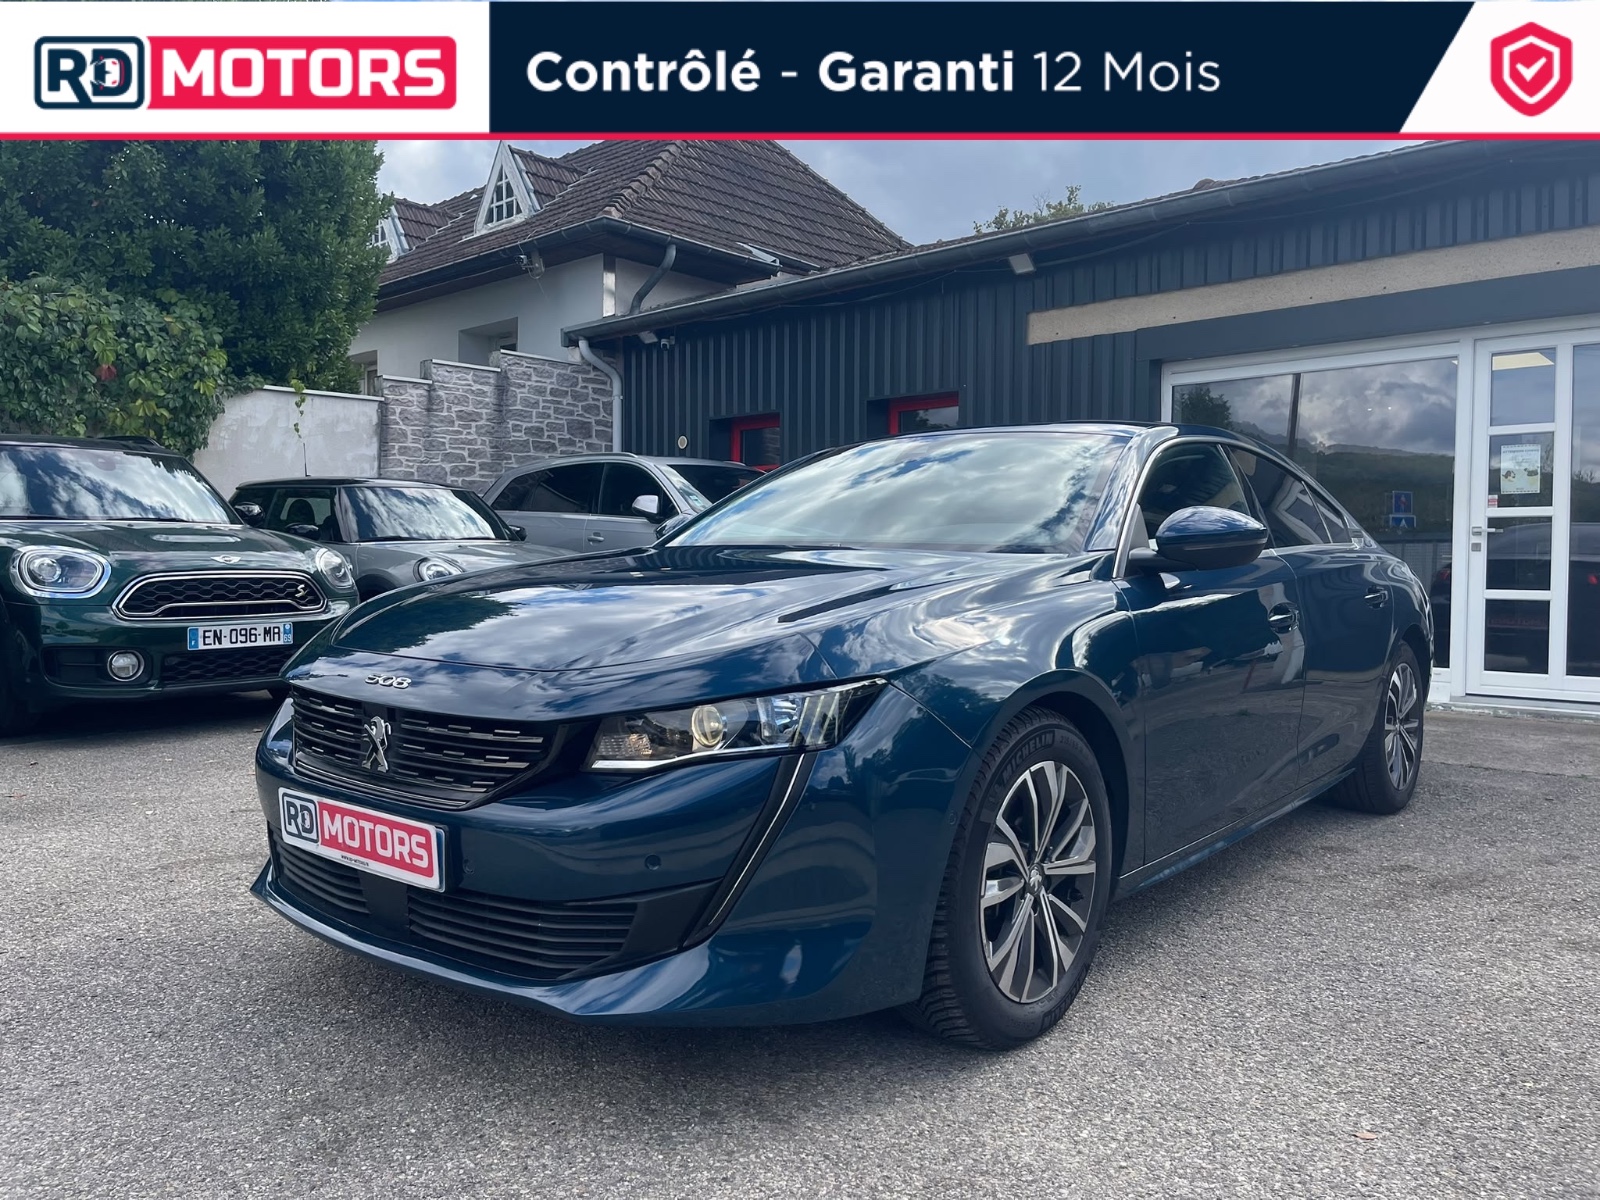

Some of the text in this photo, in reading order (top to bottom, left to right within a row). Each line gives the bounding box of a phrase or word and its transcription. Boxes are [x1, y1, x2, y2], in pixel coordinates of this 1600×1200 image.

[283, 633, 291, 642] 69
[365, 674, 412, 689] 508
[1002, 732, 1054, 783] MICHELIN
[323, 810, 429, 869] MOTORS
